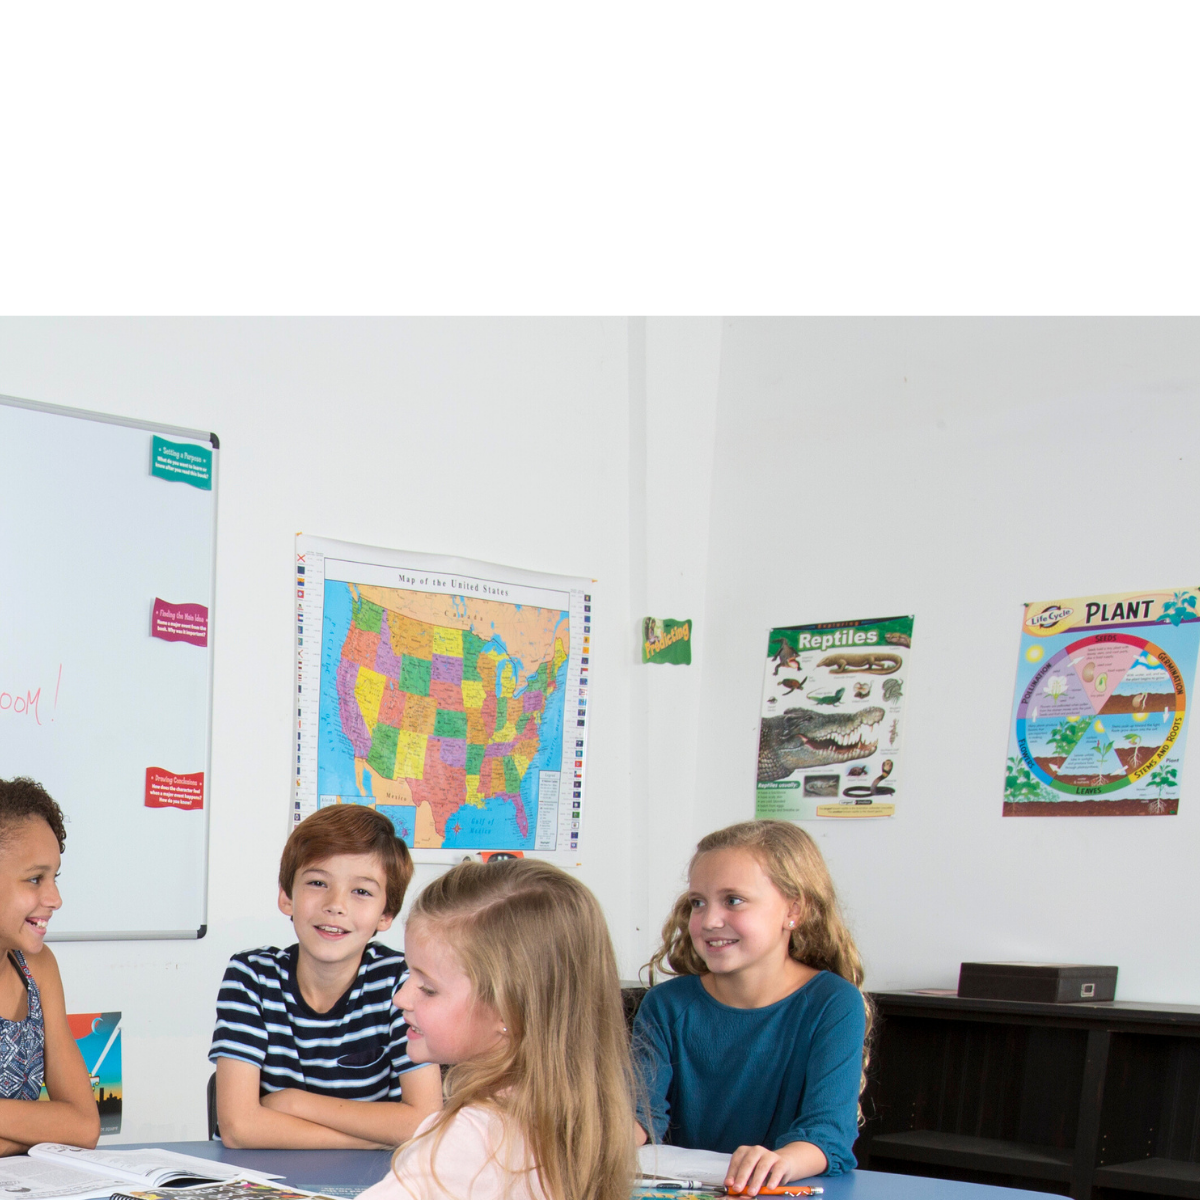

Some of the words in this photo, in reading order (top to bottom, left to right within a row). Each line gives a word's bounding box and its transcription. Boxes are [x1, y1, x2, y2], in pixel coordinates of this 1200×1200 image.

[399, 574, 416, 585] Map
[420, 577, 429, 585] of
[433, 578, 446, 587] the
[451, 579, 479, 592] United
[483, 585, 509, 596] States
[160, 609, 175, 620] Finding
[185, 613, 194, 621] Main
[195, 614, 204, 622] Idea
[1031, 614, 1048, 625] Life
[1048, 609, 1071, 620] Cycle
[1086, 600, 1154, 624] PLANT
[645, 623, 689, 659] Predicting
[800, 629, 877, 651] Reptiles
[1021, 663, 1052, 705] POLLINATION
[1158, 652, 1184, 695] GERMINATION
[1018, 738, 1034, 769] FLOWERS
[1134, 759, 1157, 779] STEMS
[1157, 745, 1169, 759] AND
[1166, 717, 1182, 742] ROOTS
